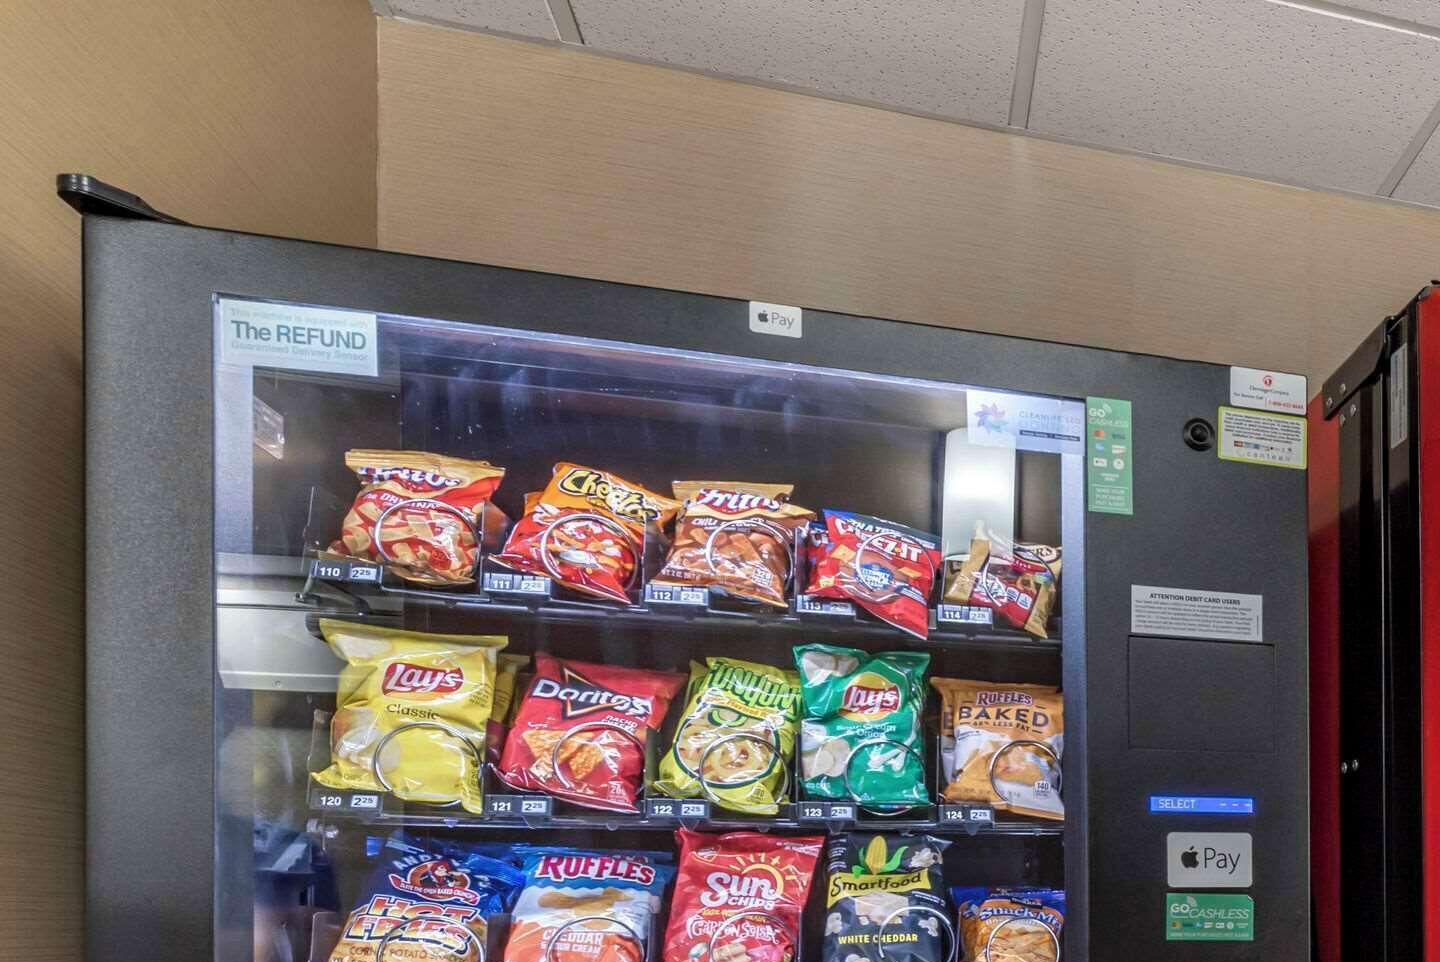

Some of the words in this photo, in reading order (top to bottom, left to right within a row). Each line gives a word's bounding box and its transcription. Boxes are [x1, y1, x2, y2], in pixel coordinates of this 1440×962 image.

[771, 311, 796, 329] Pay
[230, 319, 272, 342] The
[276, 323, 367, 351] REFUND
[1089, 408, 1106, 418] GO
[700, 487, 782, 512] Fritos
[320, 565, 341, 578] 110
[492, 579, 512, 590] 111
[652, 591, 673, 601] 112
[1149, 592, 1185, 602] ATTENTION
[1185, 595, 1203, 603] DEBIT
[944, 611, 961, 620] 114
[384, 662, 464, 693] Lay's
[532, 677, 655, 717] Doritos
[847, 685, 900, 715] Lay's
[976, 690, 1033, 706] RUFFLES
[385, 703, 441, 721] Classic
[958, 705, 1049, 728] BAKED
[319, 796, 342, 806] 120
[492, 801, 512, 811] 121
[1158, 799, 1197, 809] SELECT
[653, 805, 673, 815] 122
[804, 807, 823, 818] 123
[945, 810, 963, 820] 124
[1203, 847, 1241, 875] Pay
[535, 854, 656, 886] RUFFLES
[700, 871, 778, 907] Sun
[830, 873, 923, 897] Smartfood
[369, 896, 476, 926] HOT
[727, 895, 777, 911] CHIPS
[1170, 903, 1190, 914] GO
[1189, 908, 1250, 919] CASHLESS
[980, 906, 1035, 919] Snack
[347, 916, 470, 950] FRIES
[542, 930, 604, 945] CEDDAR
[838, 933, 870, 945] WHITE
[872, 932, 918, 944] CHEDDAR
